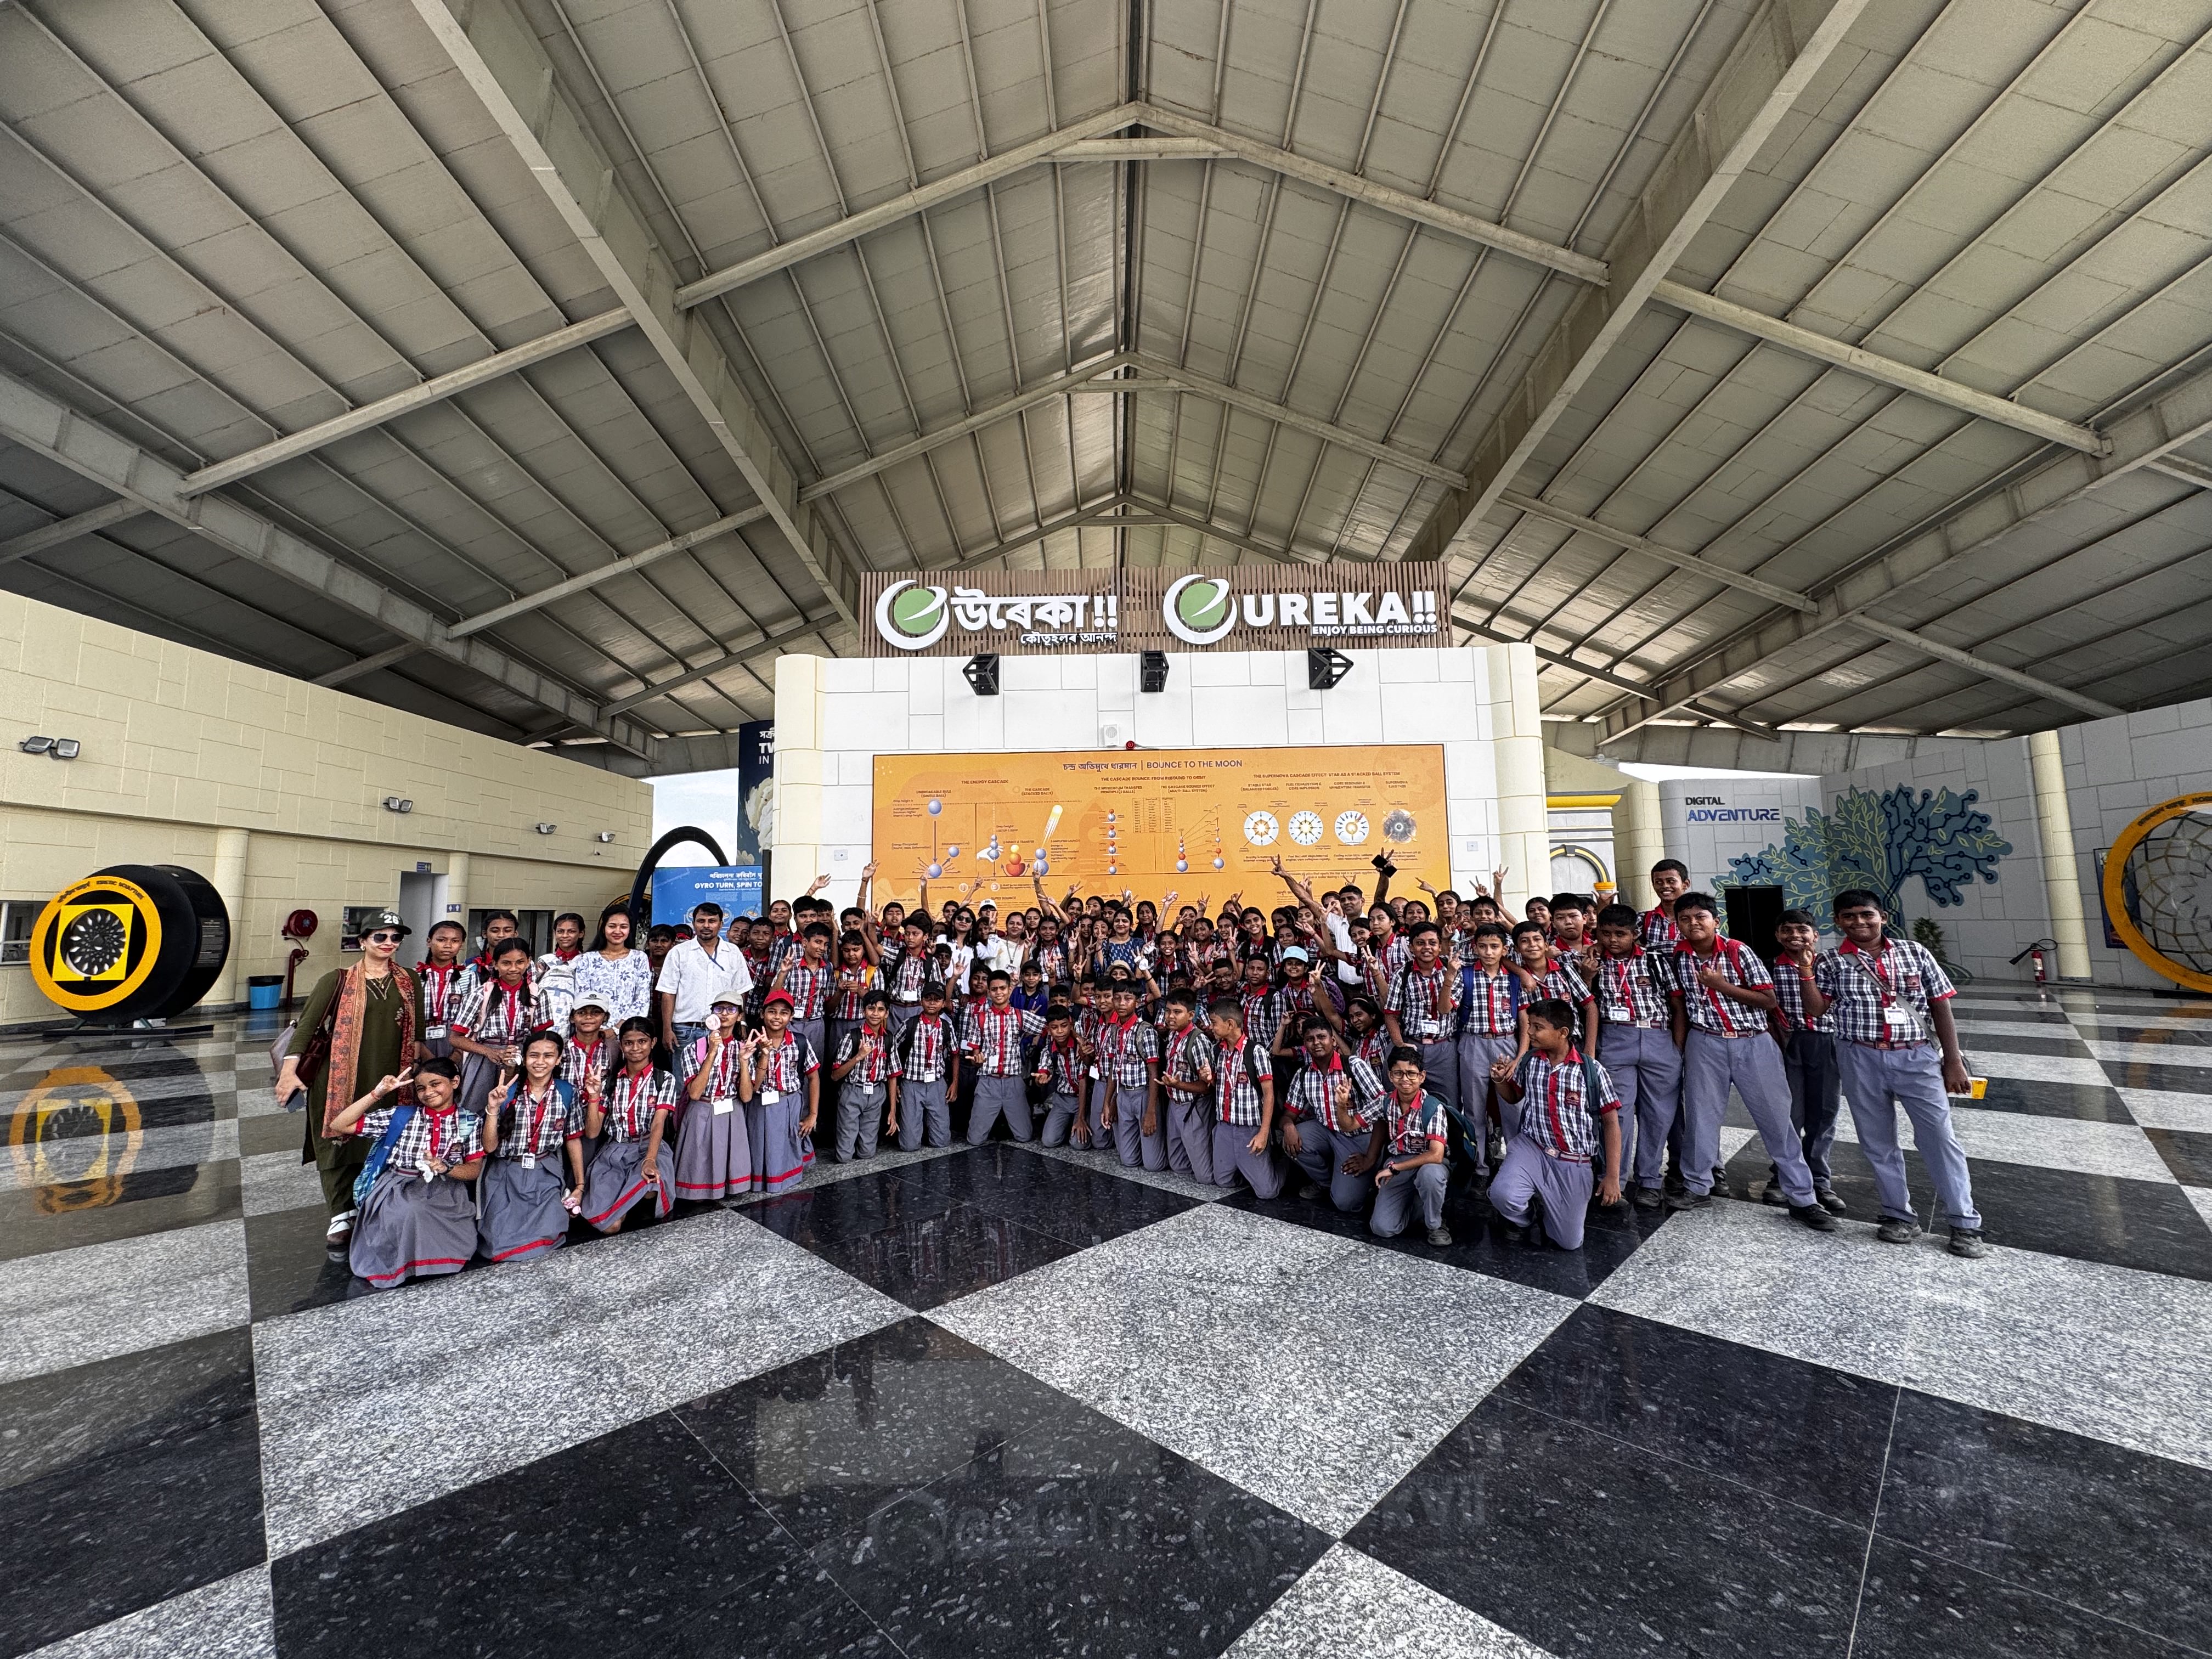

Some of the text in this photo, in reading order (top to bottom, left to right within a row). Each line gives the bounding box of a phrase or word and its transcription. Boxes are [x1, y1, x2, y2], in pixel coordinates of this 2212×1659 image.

[1312, 624, 1438, 636] ENJOY BEING CURIOUS
[1079, 632, 1118, 643] আনন্দ
[759, 755, 769, 764] IN
[1685, 797, 1725, 805] DIGITAL
[1688, 809, 1780, 822] ADVENTURE
